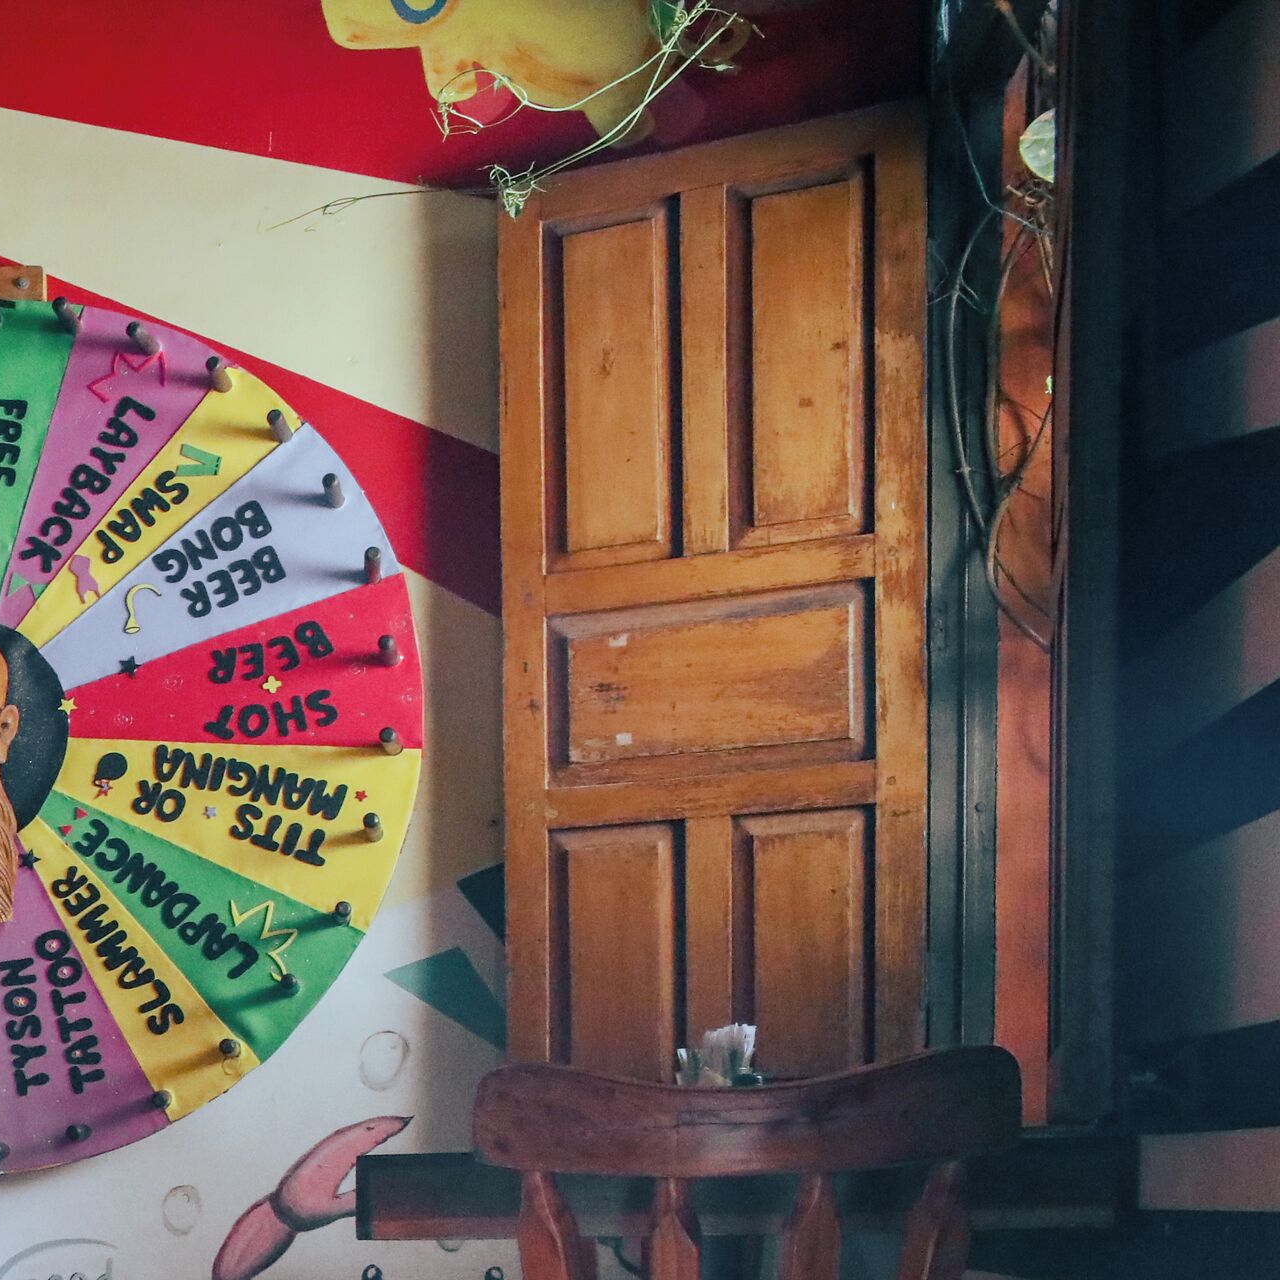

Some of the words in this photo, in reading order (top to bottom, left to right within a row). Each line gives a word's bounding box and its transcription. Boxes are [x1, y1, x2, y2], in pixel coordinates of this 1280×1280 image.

[18, 396, 156, 574] LAYBACK
[96, 470, 190, 565] SWAP
[151, 500, 273, 583] BONG
[180, 545, 287, 618] BEER
[208, 620, 335, 684] BEER
[204, 690, 338, 740] SHOT
[131, 780, 186, 822] OR
[155, 744, 349, 821] MANGINA
[230, 803, 326, 866] TITS
[51, 866, 184, 1035] SLAMMER
[35, 929, 105, 1095] TATTOO
